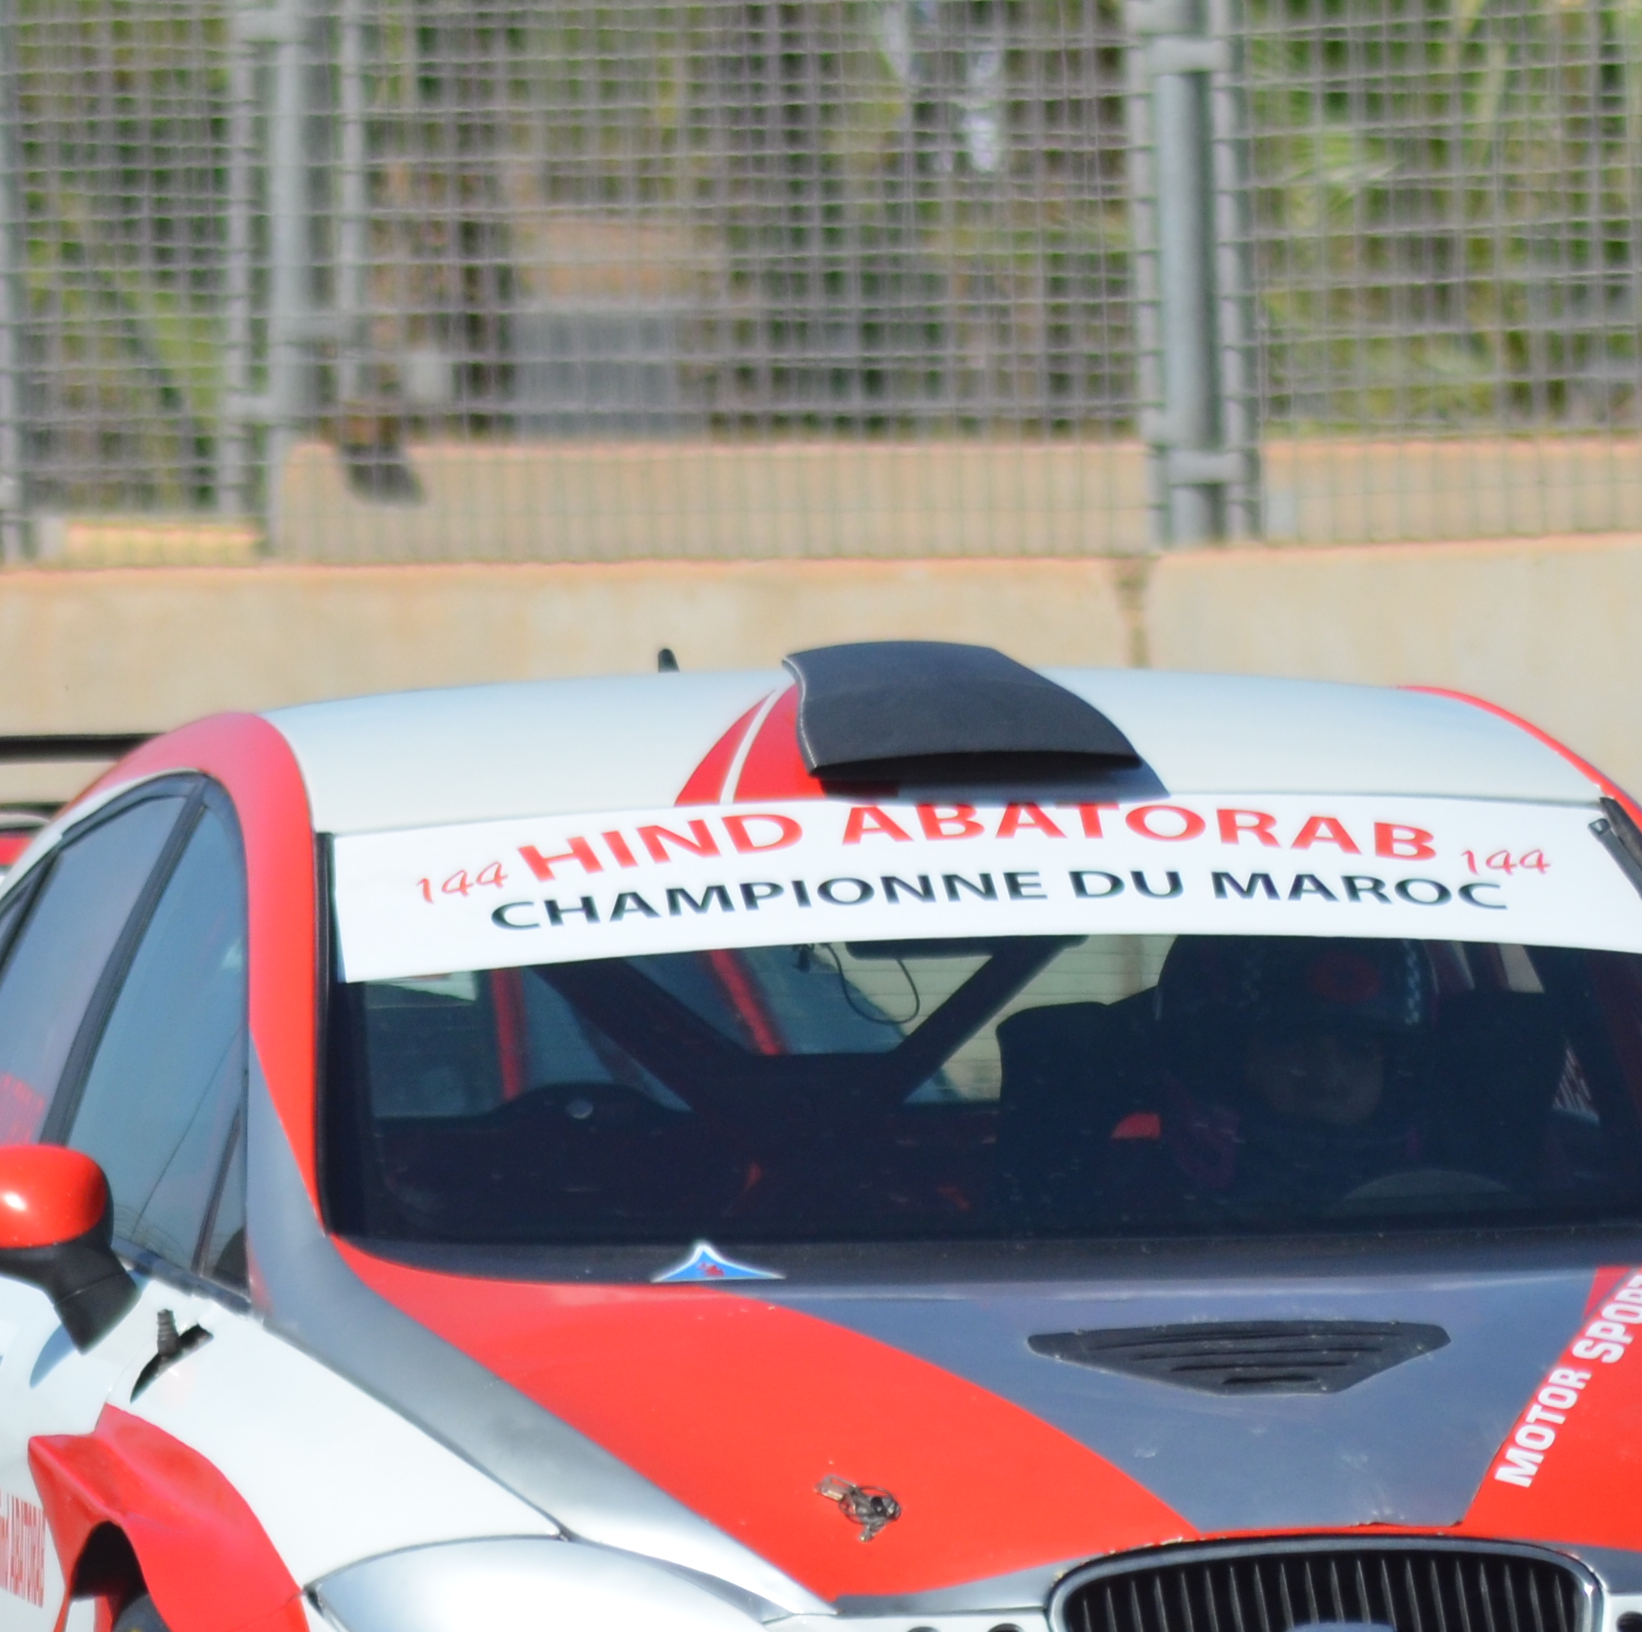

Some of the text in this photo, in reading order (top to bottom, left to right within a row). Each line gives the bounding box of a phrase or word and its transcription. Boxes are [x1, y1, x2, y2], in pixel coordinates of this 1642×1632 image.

[517, 800, 1437, 883] HIND ABATORAB
[1459, 848, 1551, 877] 144
[415, 860, 509, 905] 144
[490, 869, 1508, 931] CHAMPIONNE DU MAROC
[1494, 1367, 1593, 1488] MOTOR
